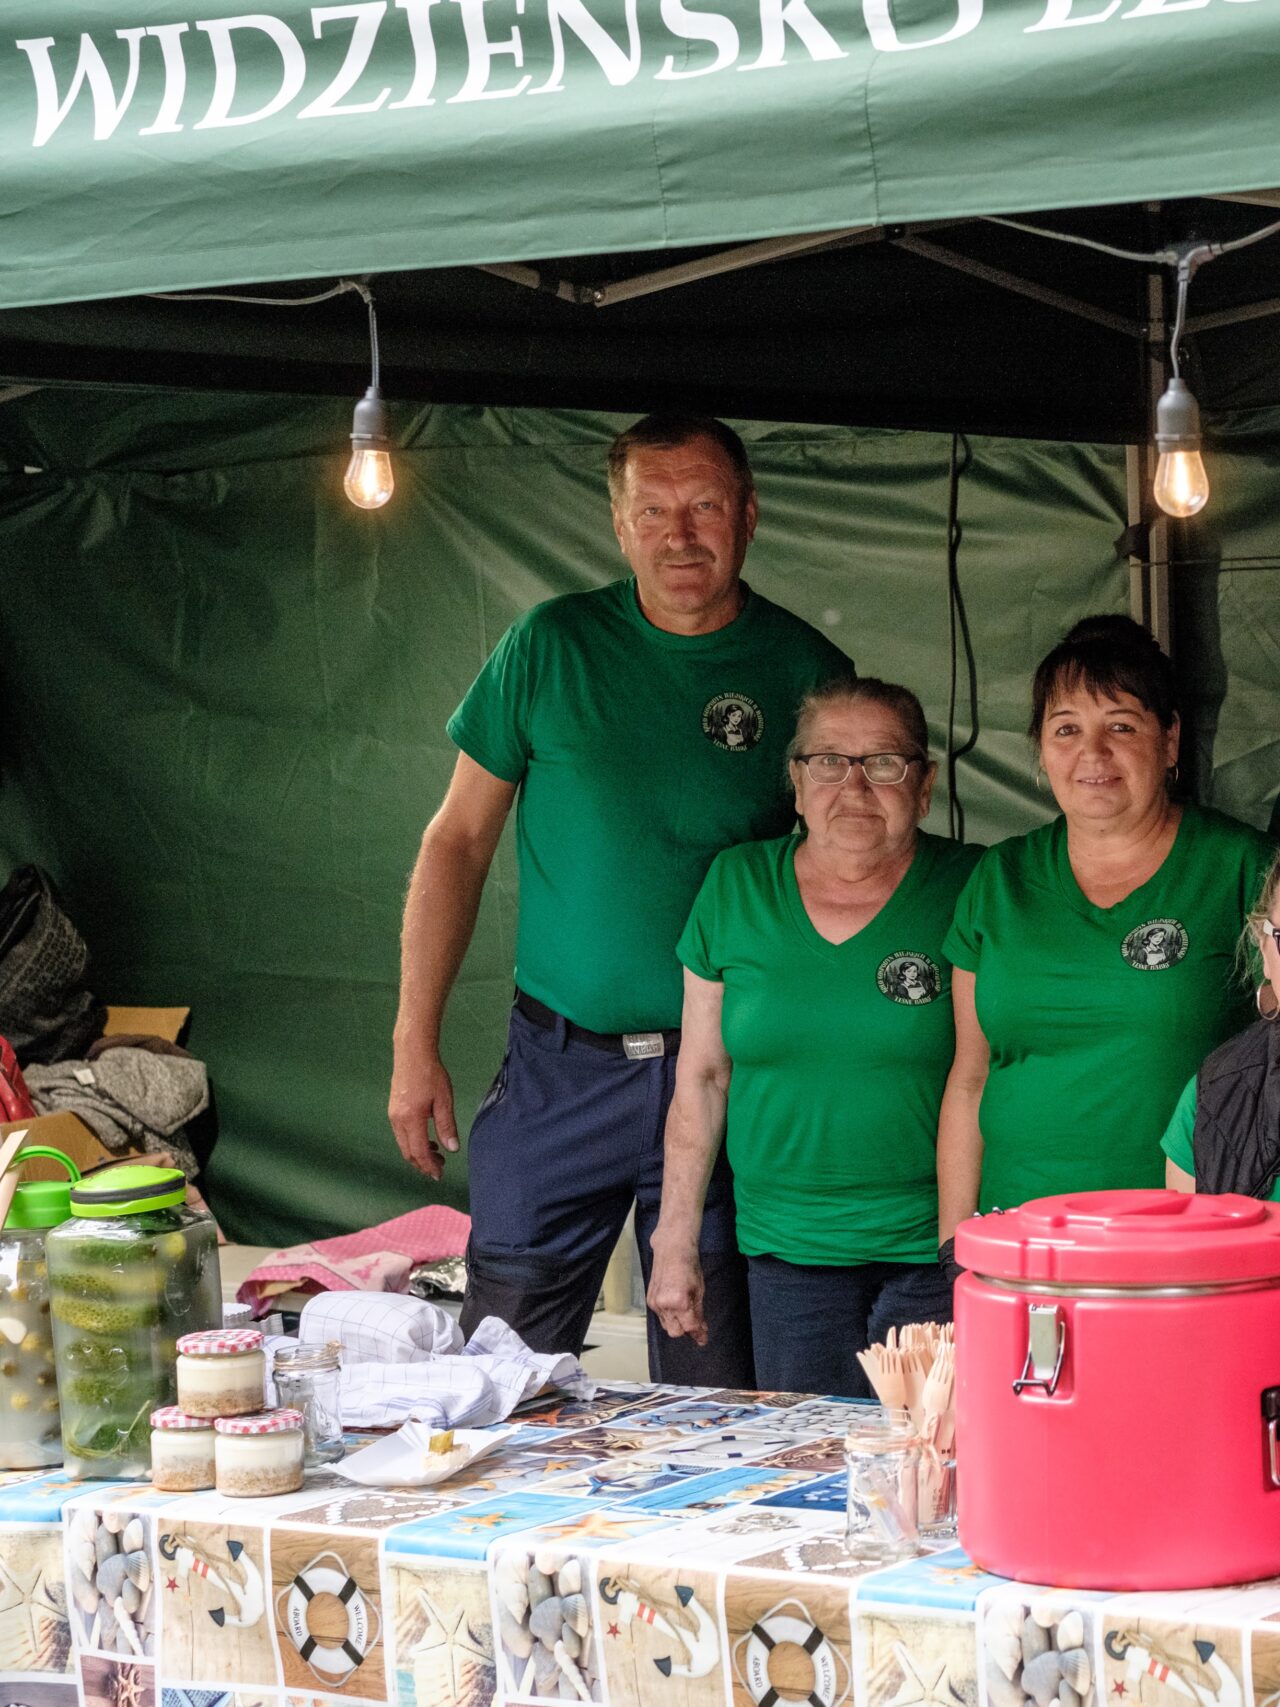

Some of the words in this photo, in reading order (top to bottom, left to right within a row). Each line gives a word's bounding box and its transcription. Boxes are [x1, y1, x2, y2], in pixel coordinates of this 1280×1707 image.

[292, 1606, 303, 1637] ABOARD
[353, 1604, 365, 1646] WELCOME
[752, 1655, 764, 1689] ABOARD
[820, 1655, 833, 1699] WELCOME
